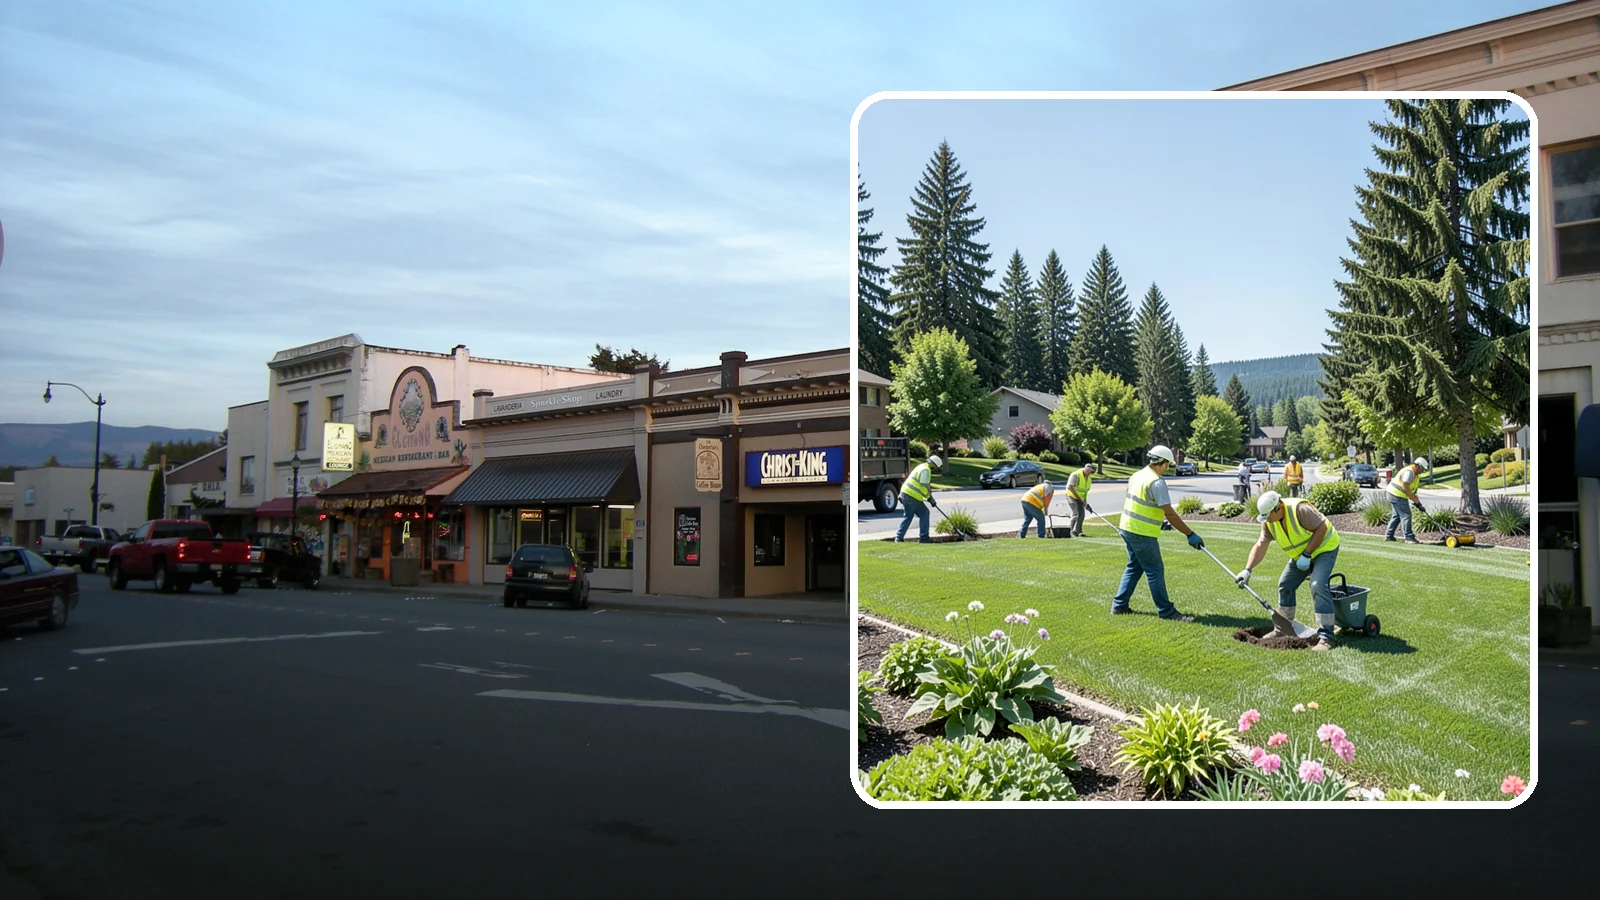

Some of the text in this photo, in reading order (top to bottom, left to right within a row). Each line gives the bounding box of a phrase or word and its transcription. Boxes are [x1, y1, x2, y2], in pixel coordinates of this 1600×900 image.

[493, 389, 624, 413] LAVANDERIA Sparkle Shop LAUNDRY
[391, 425, 402, 449] EL
[373, 454, 396, 464] MEXICAN
[397, 451, 433, 462] RESTAURANT
[437, 450, 450, 459] BAR
[760, 452, 797, 478] CHRIST
[799, 450, 827, 476] KING
[696, 480, 722, 489] Coffee House
